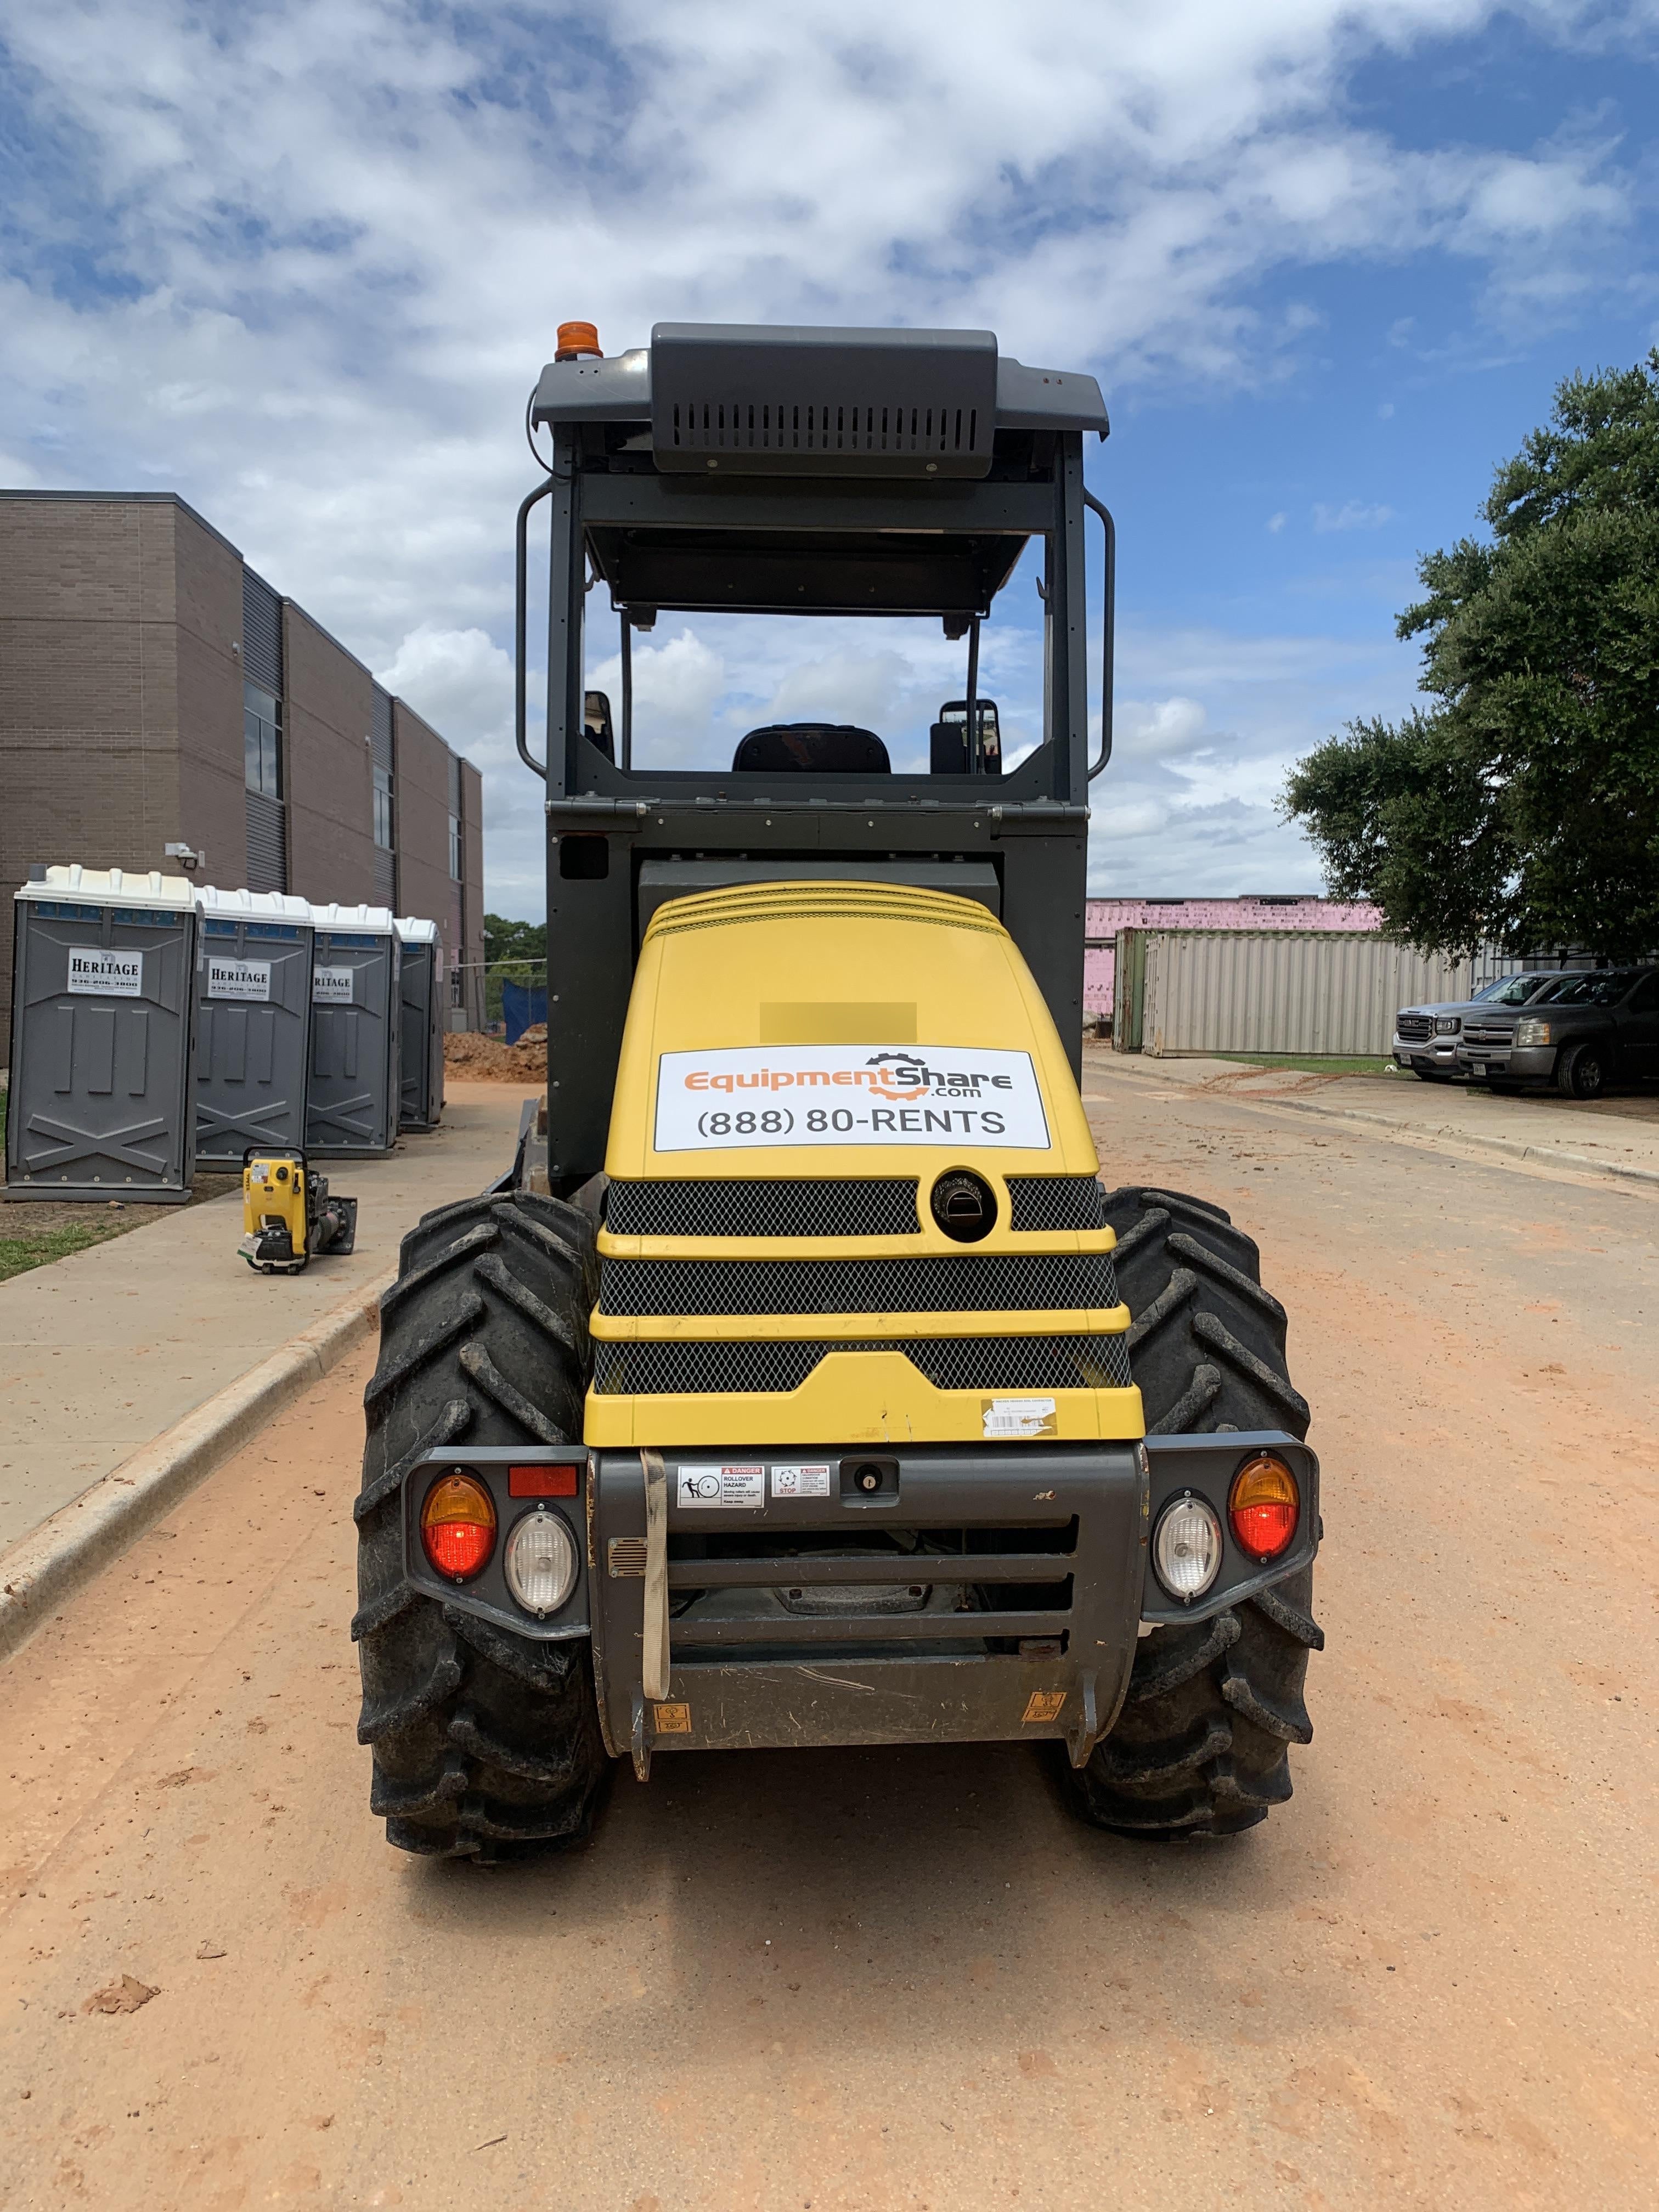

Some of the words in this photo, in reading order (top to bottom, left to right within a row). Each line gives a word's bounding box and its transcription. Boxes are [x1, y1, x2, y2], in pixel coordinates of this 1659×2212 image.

[72, 958, 138, 975] HERITAGE
[212, 968, 267, 983] HERITAGE
[315, 977, 350, 987] RITAGE
[684, 1066, 1013, 1093] EquipmentShare
[931, 1088, 981, 1098] .com
[697, 1108, 794, 1137] (888)
[806, 1108, 1006, 1134] 80-RENTS
